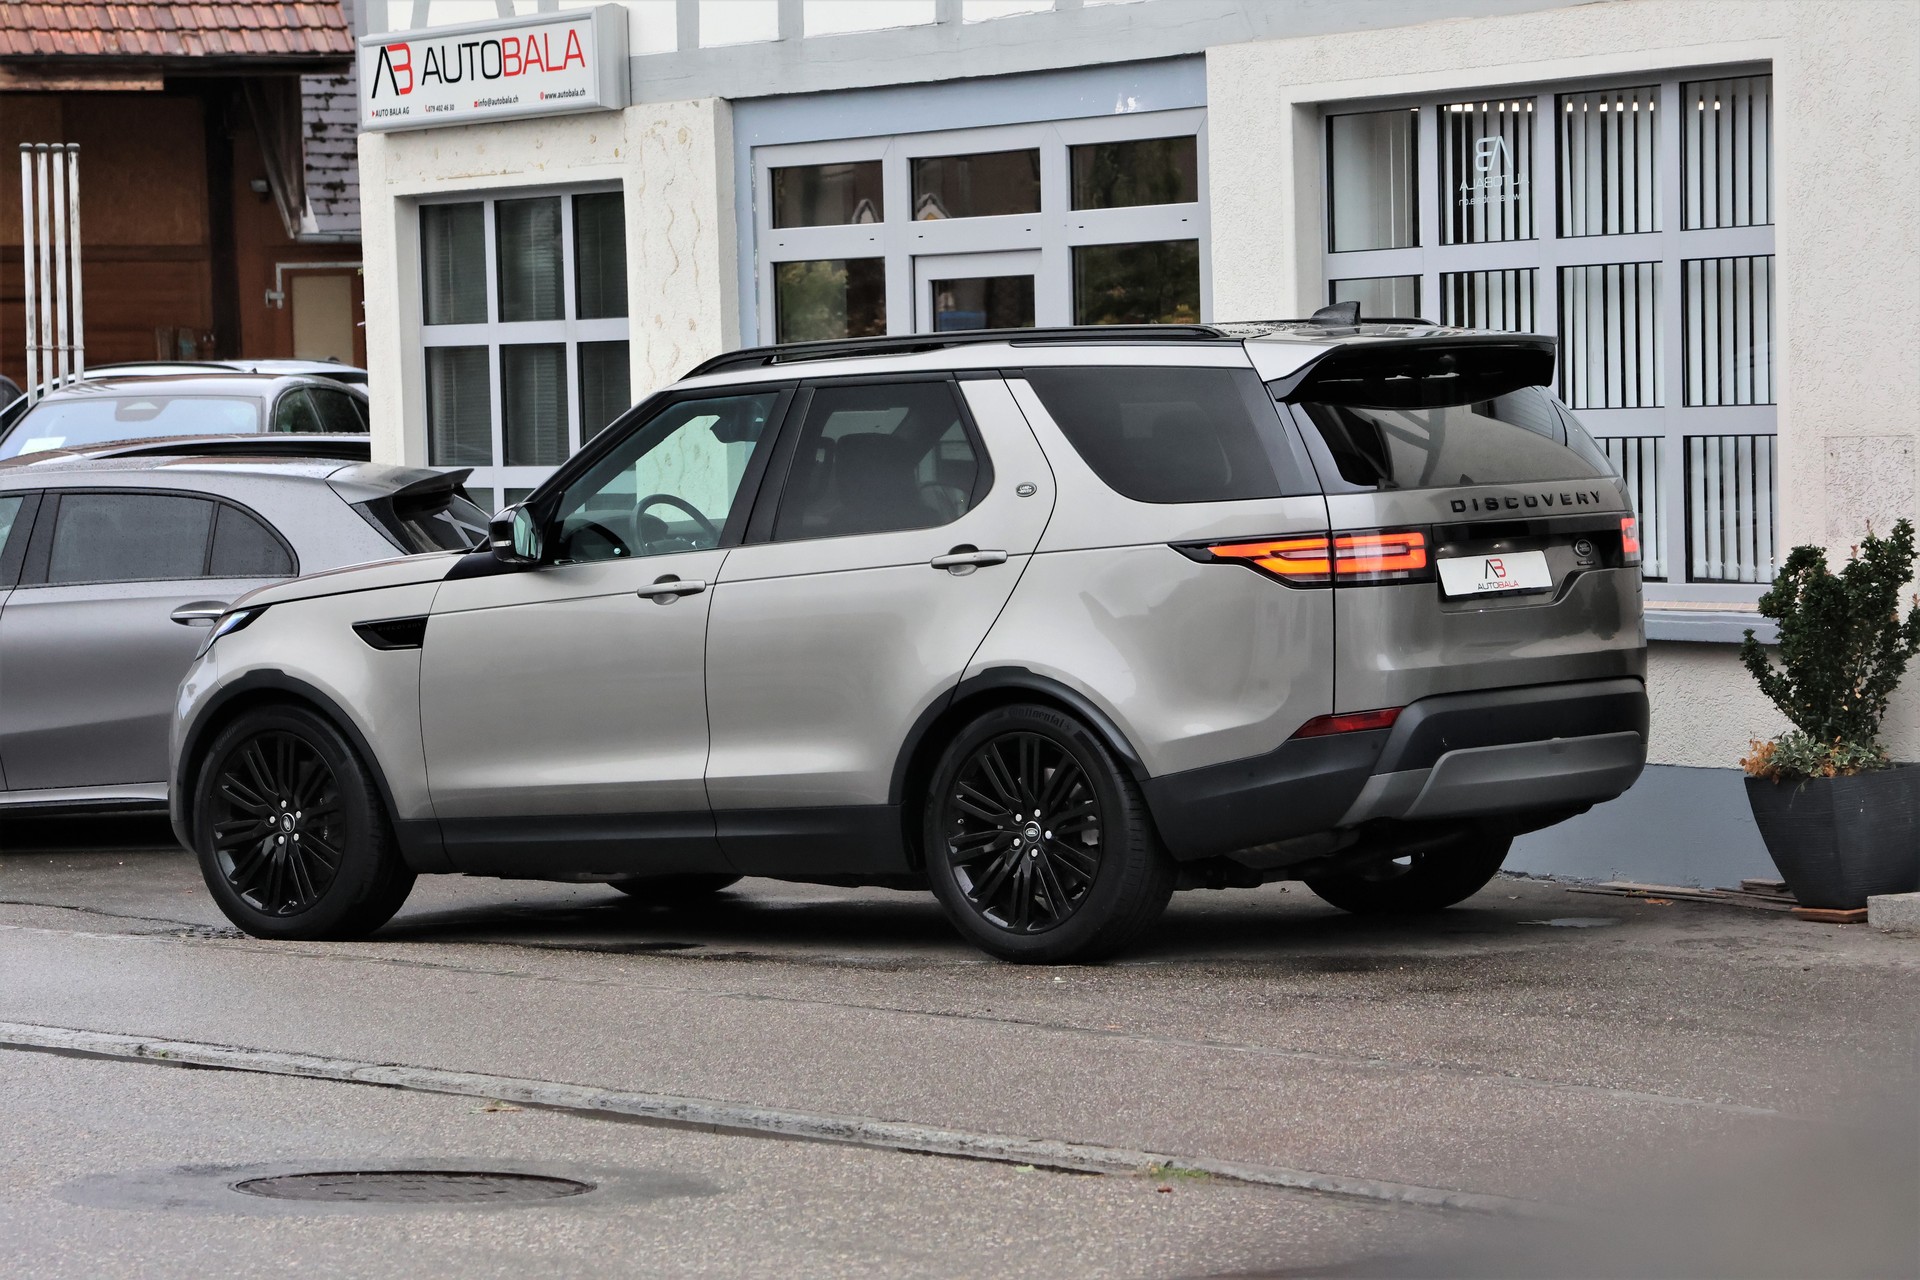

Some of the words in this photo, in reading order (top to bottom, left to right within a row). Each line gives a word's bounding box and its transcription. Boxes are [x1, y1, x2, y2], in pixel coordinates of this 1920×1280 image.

[421, 29, 586, 86] AUTOBALA
[544, 87, 586, 100] www.autobala.ch
[477, 94, 519, 108] info@autobala.ch
[375, 108, 389, 118] AUTO
[389, 107, 402, 117] BALA
[402, 106, 410, 116] AG
[1450, 490, 1601, 513] DISCOVERY
[1477, 580, 1519, 591] AUTOBALA
